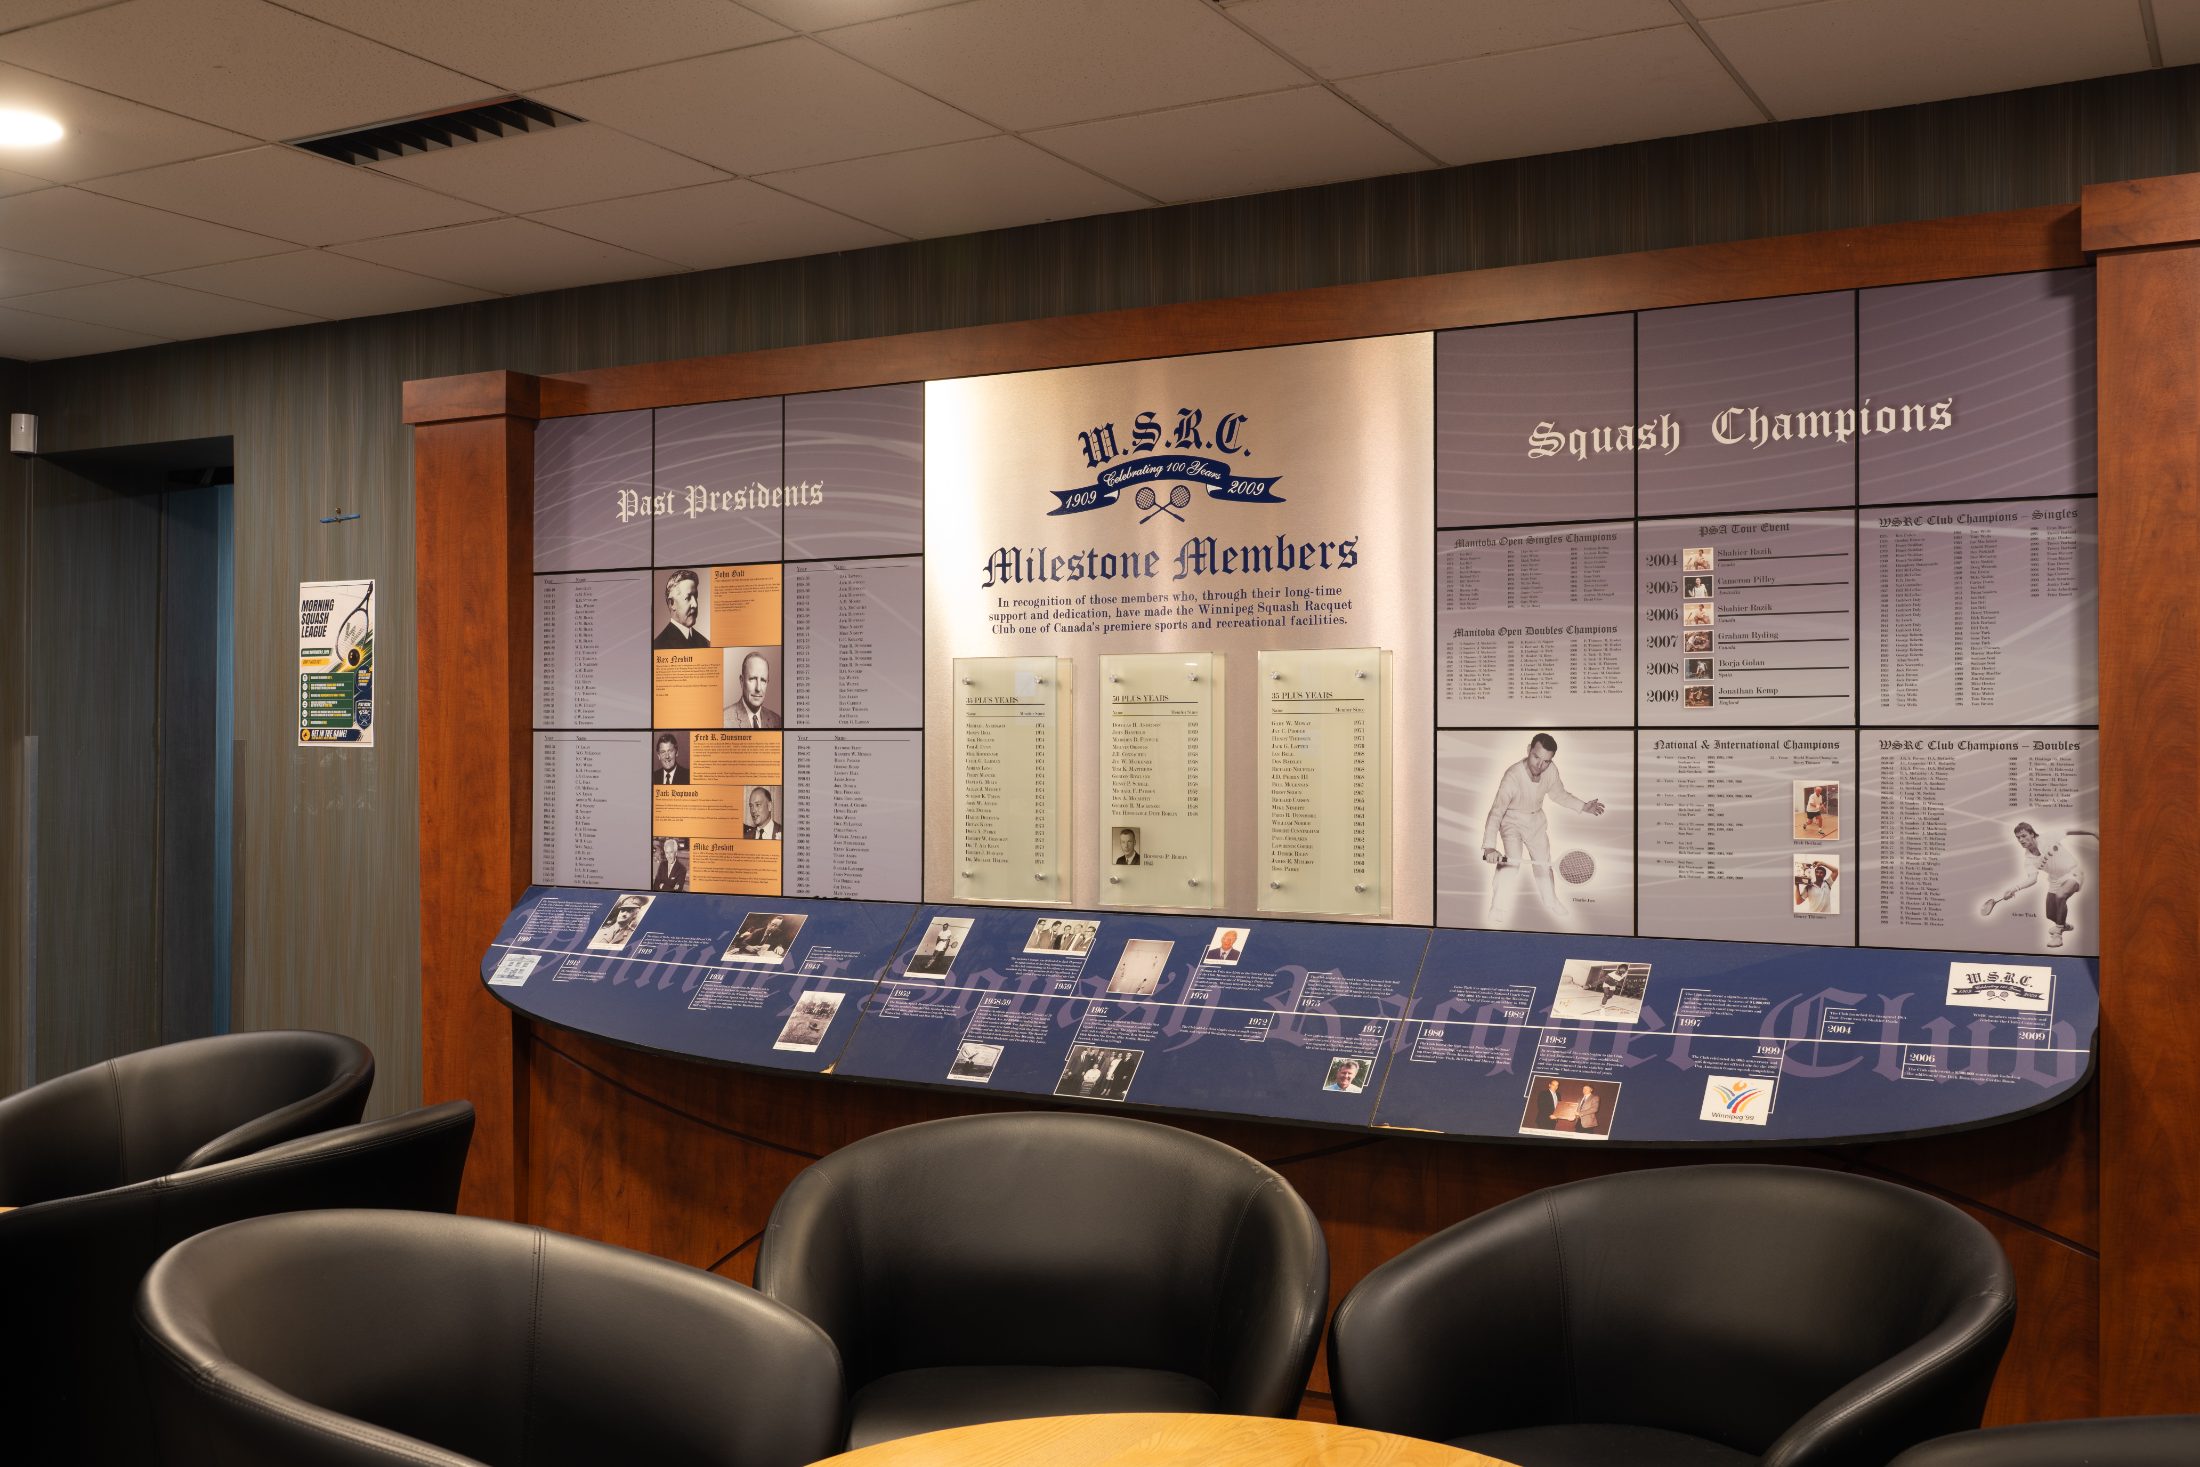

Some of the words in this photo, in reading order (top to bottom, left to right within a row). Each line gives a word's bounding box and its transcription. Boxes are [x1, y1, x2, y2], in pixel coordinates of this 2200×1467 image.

[1528, 414, 1680, 461] Squash
[1712, 397, 1952, 450] Champions
[1078, 408, 1251, 468] W.S.R.C.
[1104, 465, 1163, 486] Celebrating
[1166, 463, 1186, 472] 100
[1187, 461, 1221, 480] Years
[1228, 481, 1265, 495] 2009
[616, 489, 675, 522] Past
[685, 480, 823, 519] Presidents
[1066, 491, 1096, 508] 1909
[1879, 516, 1925, 527] WSRC
[1927, 514, 1953, 525] Club
[1957, 513, 2018, 524] Champions
[2032, 509, 2078, 520] Singles
[1700, 525, 1727, 537] PSA
[1732, 525, 1757, 533] Tour
[1761, 523, 1790, 532] Event
[1454, 539, 1496, 548] Manitoba
[1499, 537, 1522, 546] Open
[1526, 536, 1563, 545] Singles
[1566, 533, 1617, 543] Champions
[982, 546, 1160, 589] Milestone
[1172, 536, 1359, 580] Members
[1646, 554, 1678, 566] 2004
[715, 571, 729, 579] John
[1754, 576, 1775, 584] Pilley
[1646, 582, 1678, 594] 2005
[998, 598, 1008, 607] In
[1013, 596, 1072, 608] recognition
[1076, 595, 1086, 605] of
[1090, 594, 1117, 604] those
[1121, 593, 1168, 603] members
[1173, 592, 1198, 603] who,
[1202, 589, 1247, 601] through
[1252, 588, 1280, 599] their
[1285, 585, 1342, 599] long-time
[301, 599, 334, 612] MORNING
[989, 612, 1027, 623] support
[1030, 611, 1049, 620] and
[1053, 608, 1111, 620] dedication,
[1116, 608, 1140, 617] have
[1144, 606, 1172, 617] made
[1177, 605, 1193, 615] the
[1199, 603, 1254, 616] Winnipeg
[1257, 601, 1299, 613] Squash
[1305, 599, 1352, 611] Racquet
[301, 612, 329, 625] SQUASH
[1646, 608, 1678, 621] 2006
[992, 625, 1015, 634] Club
[1040, 623, 1050, 632] of
[1054, 622, 1100, 633] Canada's
[1103, 621, 1152, 634] premiere
[1155, 622, 1188, 630] sports
[1191, 618, 1212, 629] and
[1216, 616, 1286, 628] recreational
[1290, 614, 1347, 625] facilities.
[301, 625, 327, 638] LEAGUE
[1453, 628, 1495, 638] Manitoba
[1498, 627, 1522, 636] Open
[1525, 626, 1563, 635] Doubles
[1566, 625, 1617, 634] Champions
[1752, 631, 1779, 640] Ryding
[1646, 636, 1678, 648] 2007
[1646, 662, 1678, 675] 2008
[1646, 690, 1678, 702] 2009
[1756, 687, 1778, 695] Kemp
[694, 734, 709, 742] Fred
[1654, 740, 1698, 750] National
[1714, 740, 1779, 750] International
[1783, 740, 1840, 750] Champions
[1879, 740, 1923, 750] WSRC
[1928, 741, 1954, 750] Club
[1958, 741, 2019, 751] Champions
[2033, 741, 2080, 750] Doubles
[693, 843, 709, 851] Mike
[711, 843, 734, 851] Nesbitt
[566, 959, 581, 967] 1912
[1966, 972, 2033, 987] W.S.R.C.
[1055, 982, 1072, 990] 1959
[894, 989, 911, 997] 1952
[1190, 991, 1209, 1000] 1970
[1302, 998, 1321, 1007] 1975
[1091, 1006, 1108, 1014] 1967
[1503, 1010, 1524, 1018] 1982
[1248, 1017, 1268, 1027] 1972
[1679, 1018, 1701, 1027] 1997
[1363, 1024, 1382, 1034] 1977
[1423, 1028, 1444, 1037] 1980
[1827, 1025, 1851, 1034] 2004
[1545, 1035, 1566, 1044] 1983
[1760, 987, 2076, 1088] Club
[2018, 1032, 2046, 1040] 2009
[1756, 1046, 1780, 1055] 1999
[1910, 1053, 1935, 1062] 2006
[1711, 1112, 1743, 1121] Winnipeg
